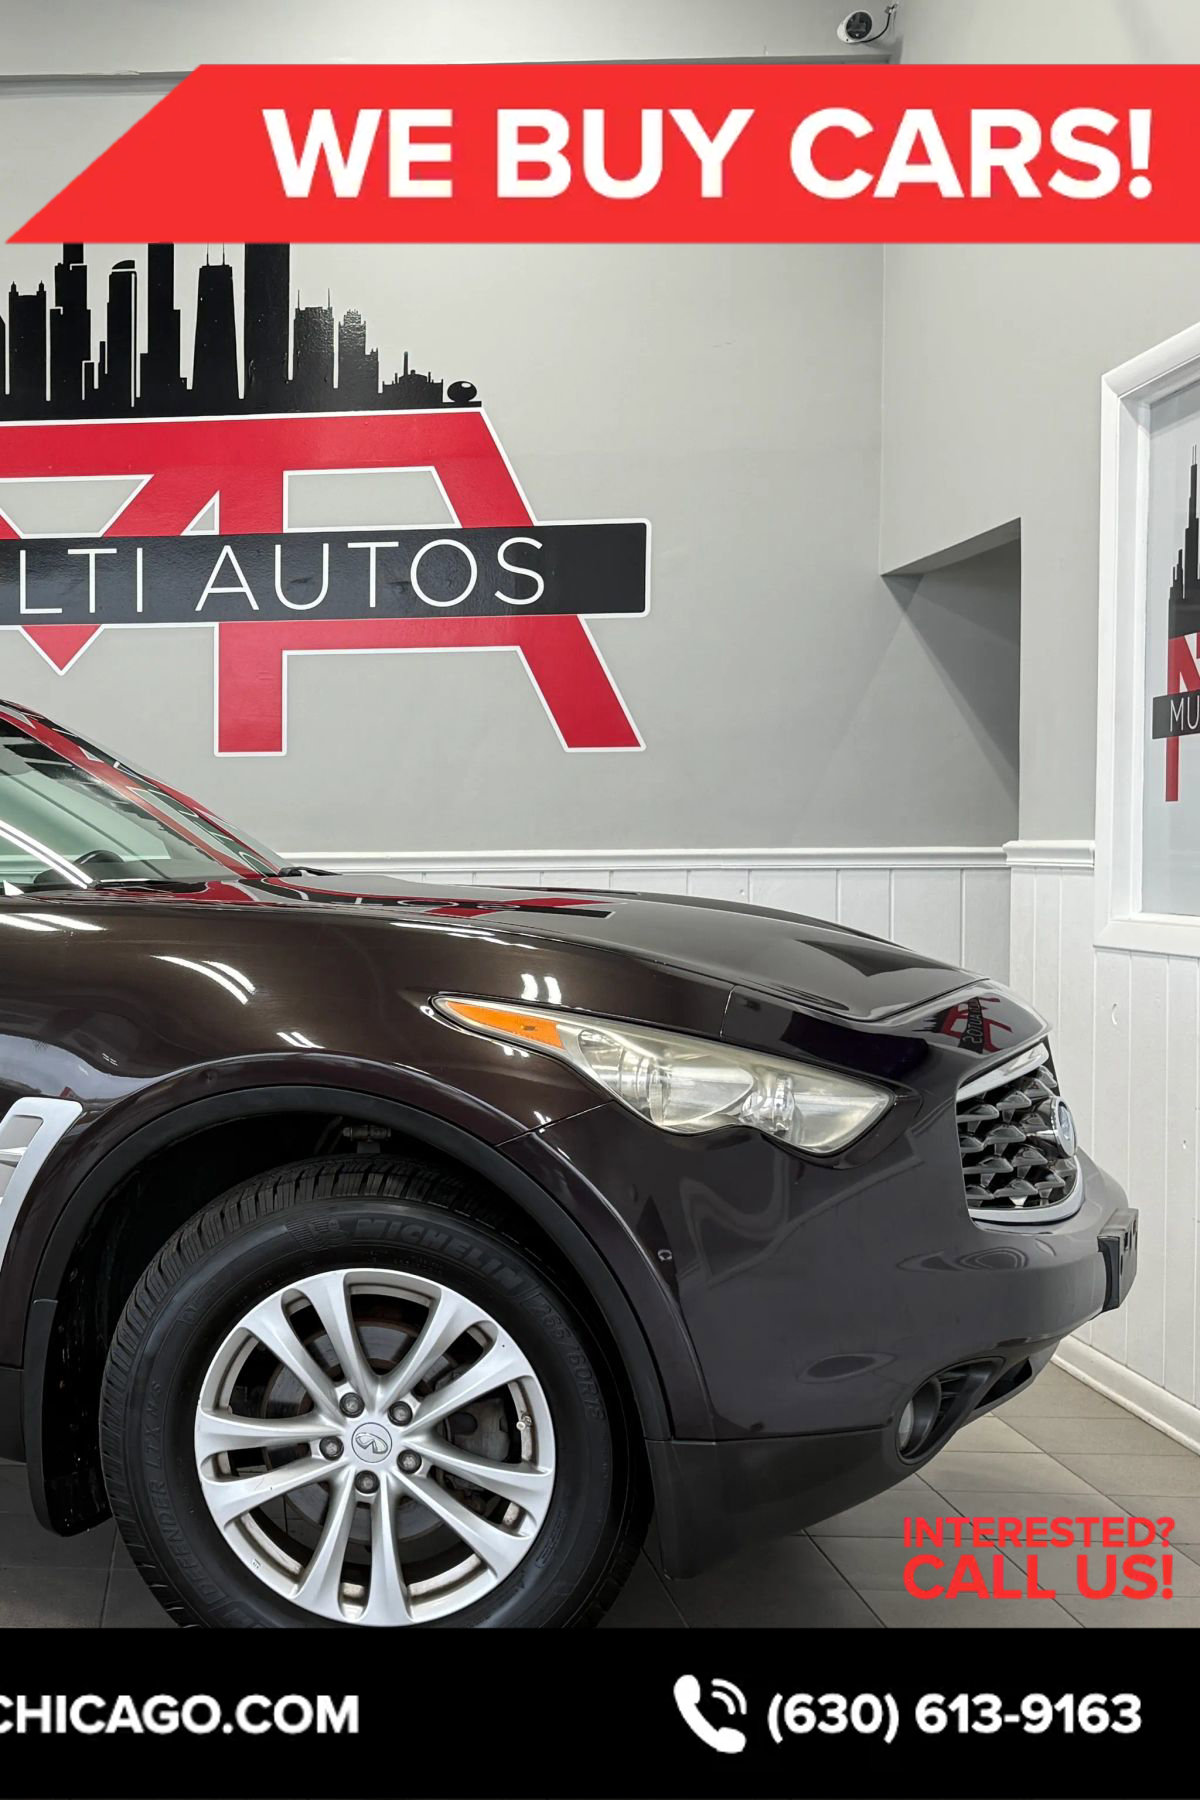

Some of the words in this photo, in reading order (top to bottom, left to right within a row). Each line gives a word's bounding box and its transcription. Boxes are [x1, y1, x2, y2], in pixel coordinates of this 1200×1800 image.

[195, 537, 546, 612] AUTOS
[353, 1217, 526, 1295] MICHELIN
[147, 1479, 220, 1598] DEFENDER
